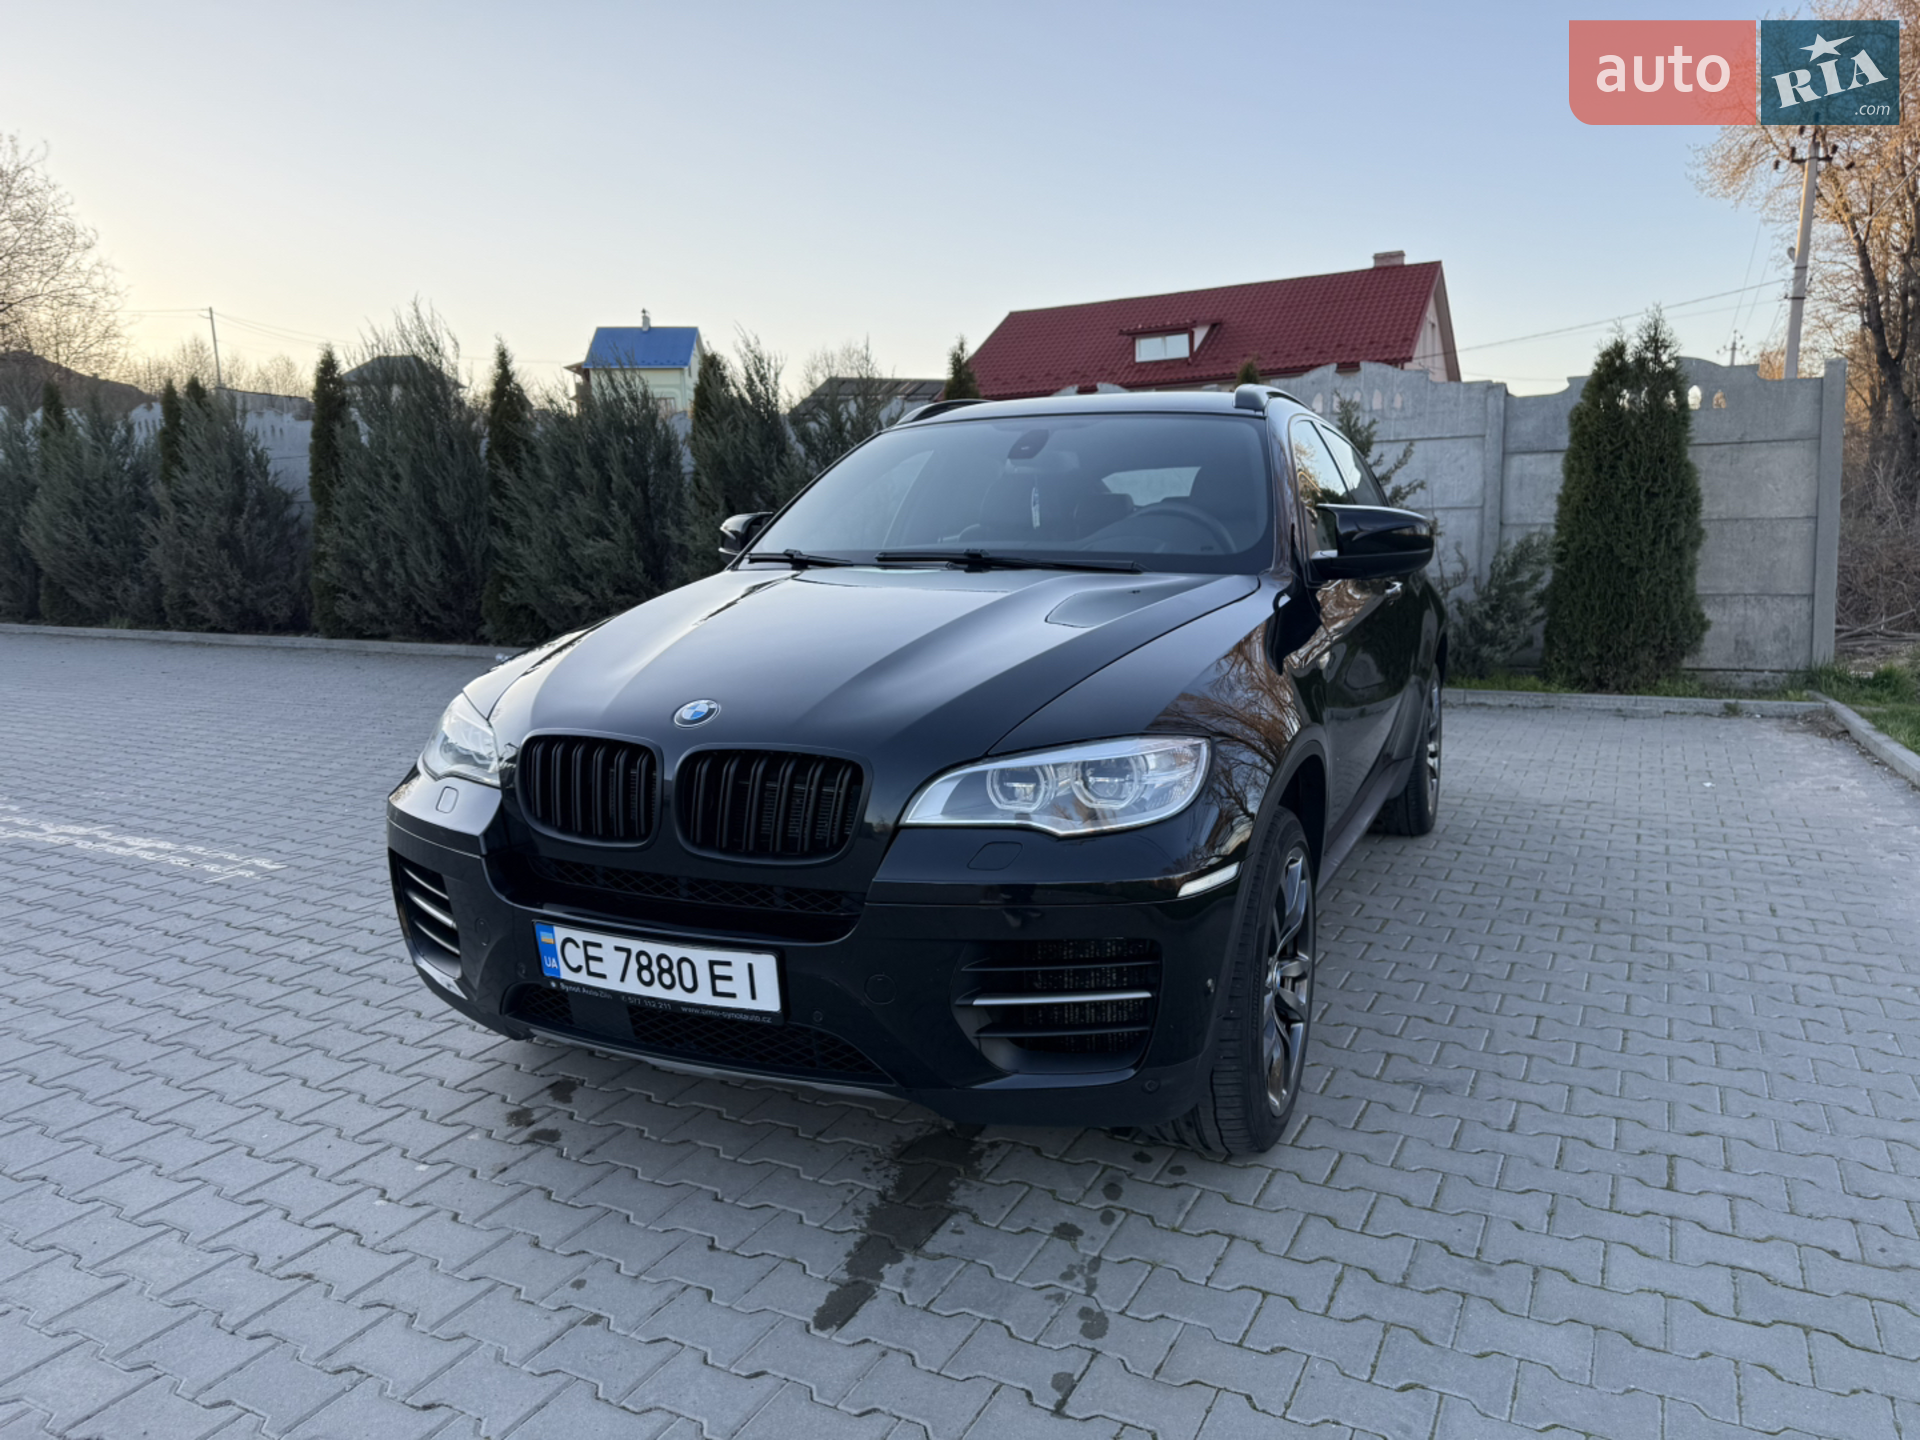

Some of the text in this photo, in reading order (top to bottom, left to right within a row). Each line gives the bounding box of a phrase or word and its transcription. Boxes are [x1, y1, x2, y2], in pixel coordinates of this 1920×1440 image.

[543, 955, 558, 970] UA
[560, 936, 607, 980] CE
[613, 945, 699, 994] 7880
